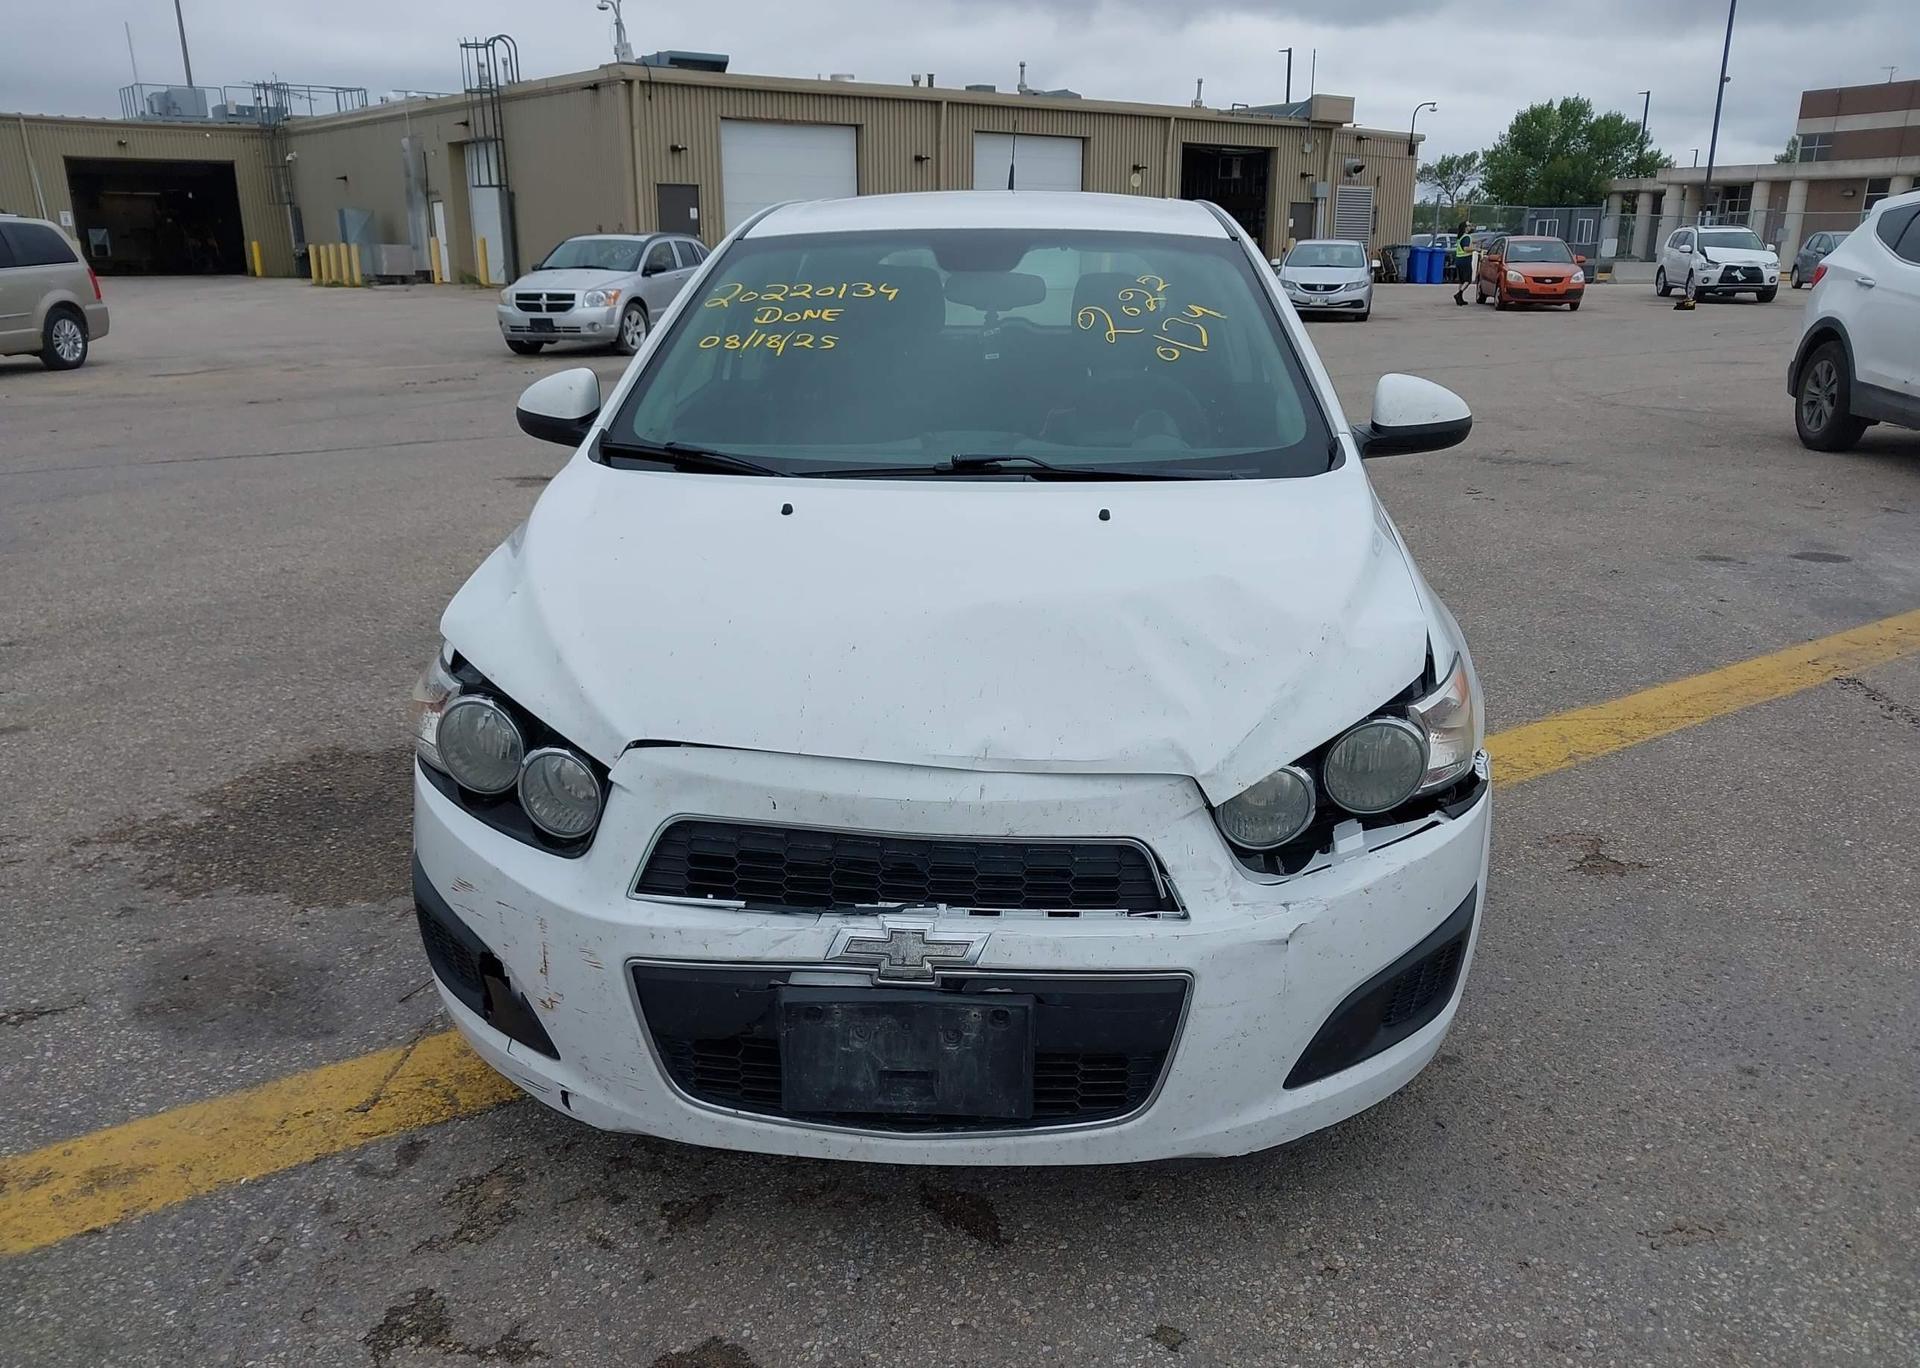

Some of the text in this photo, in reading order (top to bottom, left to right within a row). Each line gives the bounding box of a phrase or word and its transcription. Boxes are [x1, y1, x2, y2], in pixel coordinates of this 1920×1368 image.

[704, 282, 900, 309] 20220134
[753, 306, 845, 324] DONE
[698, 329, 840, 357] 08/18/25
